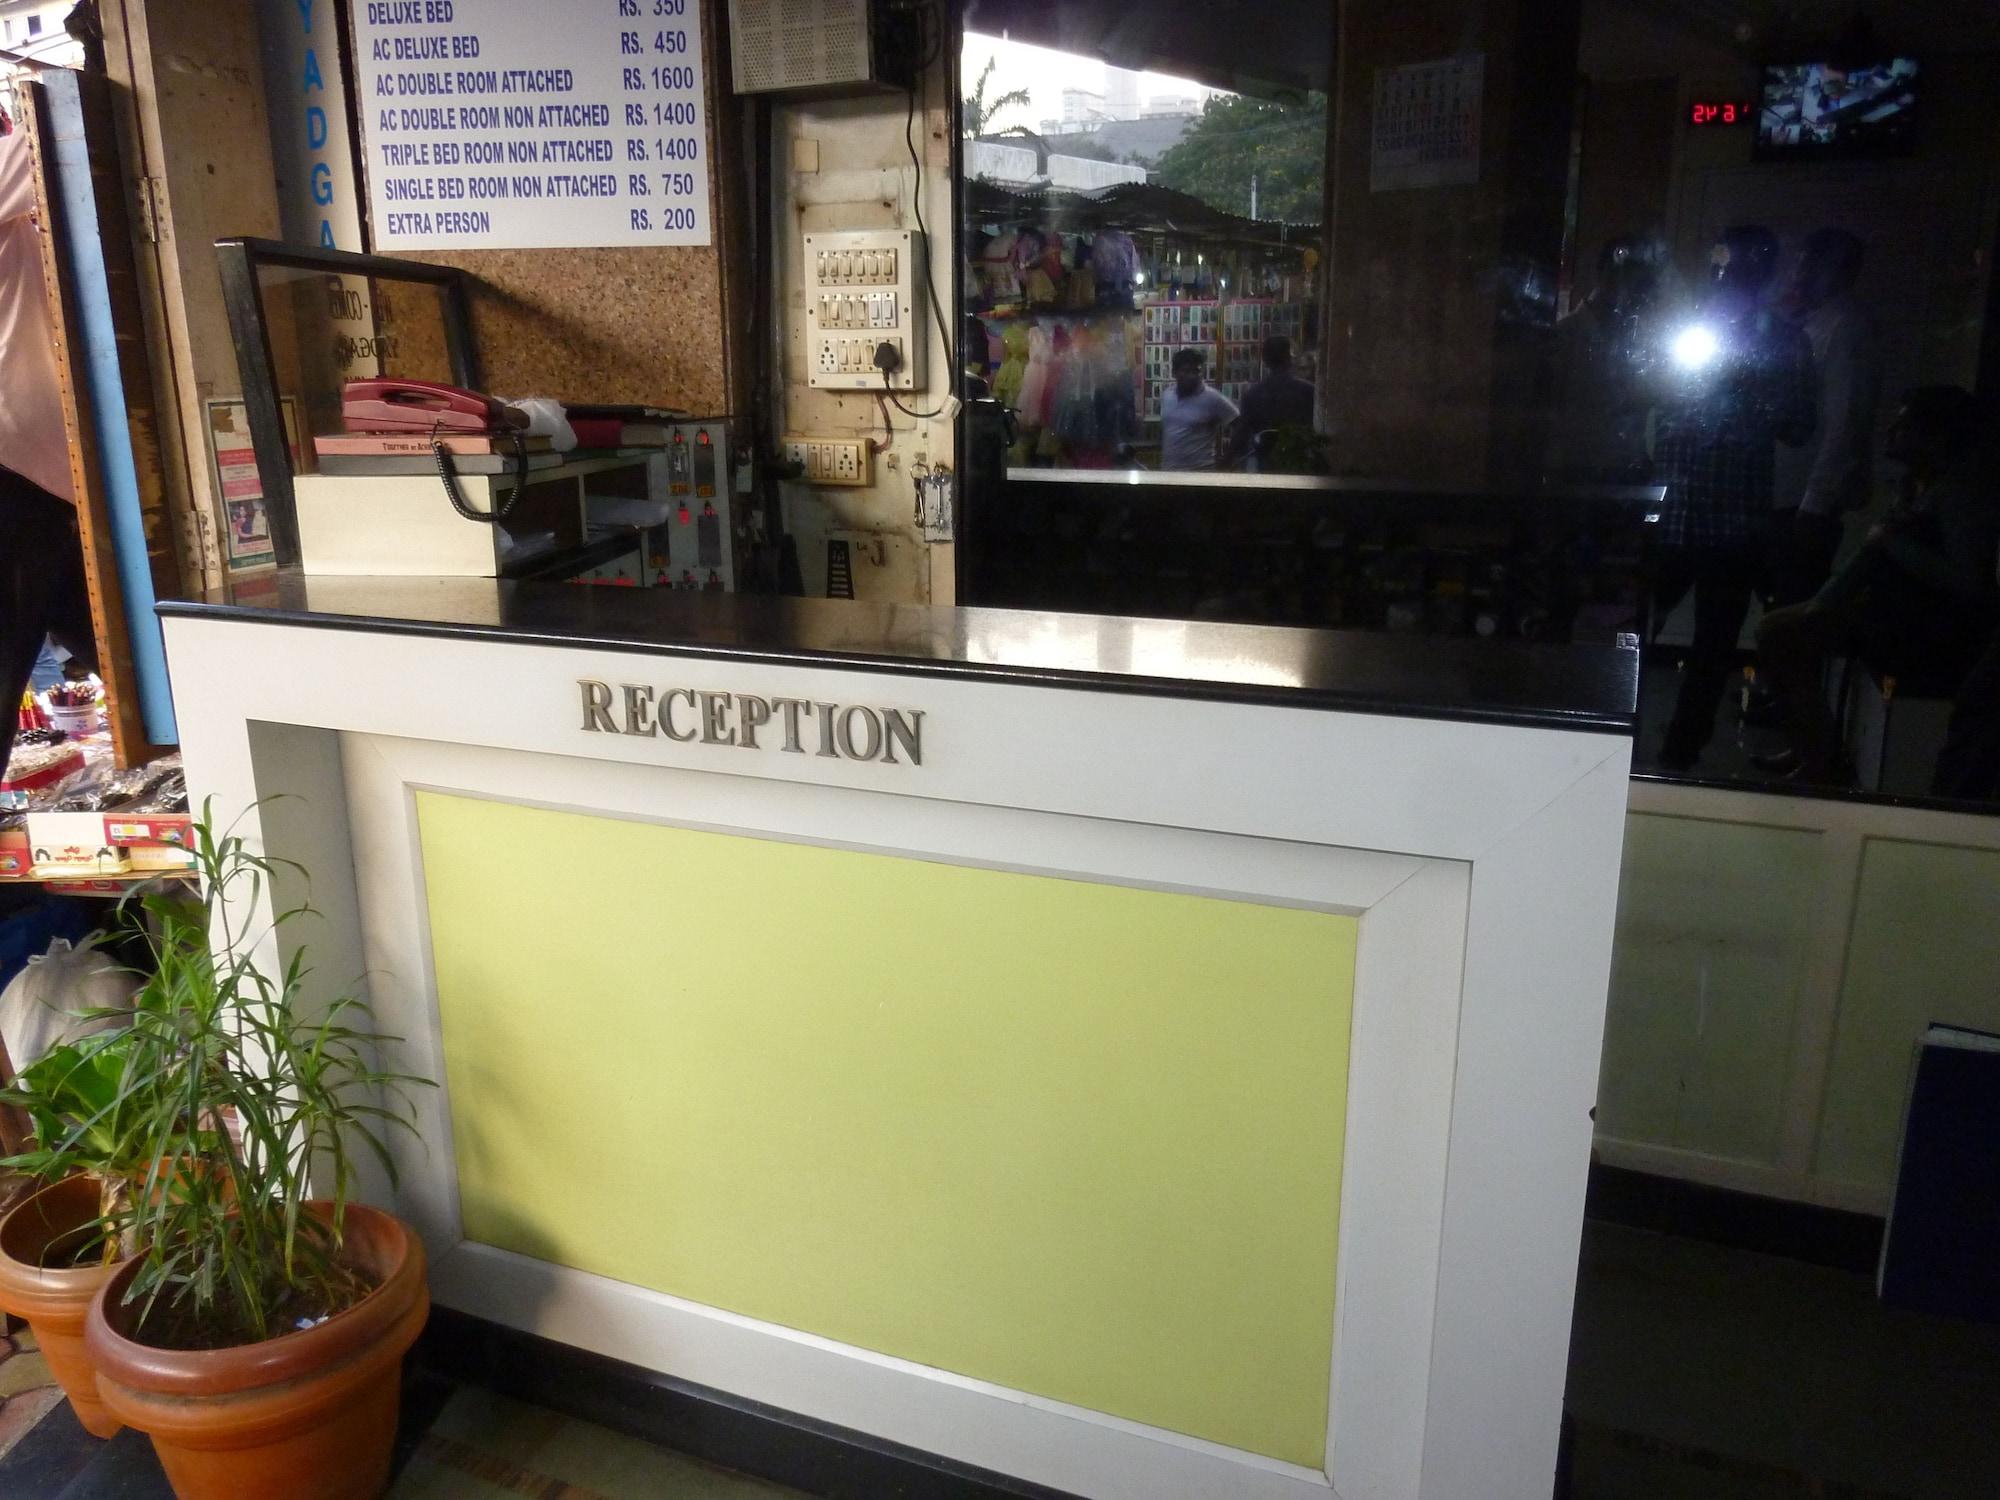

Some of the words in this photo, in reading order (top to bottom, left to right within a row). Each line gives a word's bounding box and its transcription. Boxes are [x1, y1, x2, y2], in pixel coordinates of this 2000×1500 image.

[368, 1, 422, 24] DELUXE
[426, 1, 453, 23] BED
[619, 0, 641, 16] RS.
[654, 0, 684, 15] 350
[374, 38, 390, 60] AC
[395, 37, 448, 59] DELUXE
[452, 36, 479, 58] BED
[621, 32, 643, 54] RS.
[655, 31, 686, 53] 450
[377, 74, 393, 95] AC
[398, 73, 453, 95] DOUBLE
[457, 71, 497, 93] ROOM
[503, 70, 573, 92] ATTACHED
[624, 68, 645, 90] RS.
[652, 67, 693, 89] 1600
[380, 110, 397, 130] AC
[401, 108, 456, 130] DOUBLE
[460, 107, 500, 129] ROOM
[504, 106, 533, 128] NON
[539, 105, 609, 127] ATTACHED
[625, 104, 647, 125] RS.
[654, 103, 695, 125] 1400
[382, 144, 429, 165] TRIPLE
[433, 143, 459, 164] BED
[464, 142, 503, 163] ROOM
[508, 141, 537, 163] NON
[543, 140, 612, 162] ATTACHED
[627, 139, 649, 160] RS.
[656, 138, 697, 160] 1400
[386, 179, 434, 200] SINGLE
[438, 178, 464, 199] BED
[469, 177, 508, 198] ROOM
[513, 176, 541, 197] NON
[547, 175, 616, 197] ATTACHED
[629, 174, 650, 195] RS.
[662, 173, 693, 195] 750
[388, 213, 432, 234] EXTRA
[436, 212, 489, 233] PERSON
[631, 209, 652, 230] RS.
[664, 208, 695, 229] 200
[576, 679, 926, 766] RECEPTION
